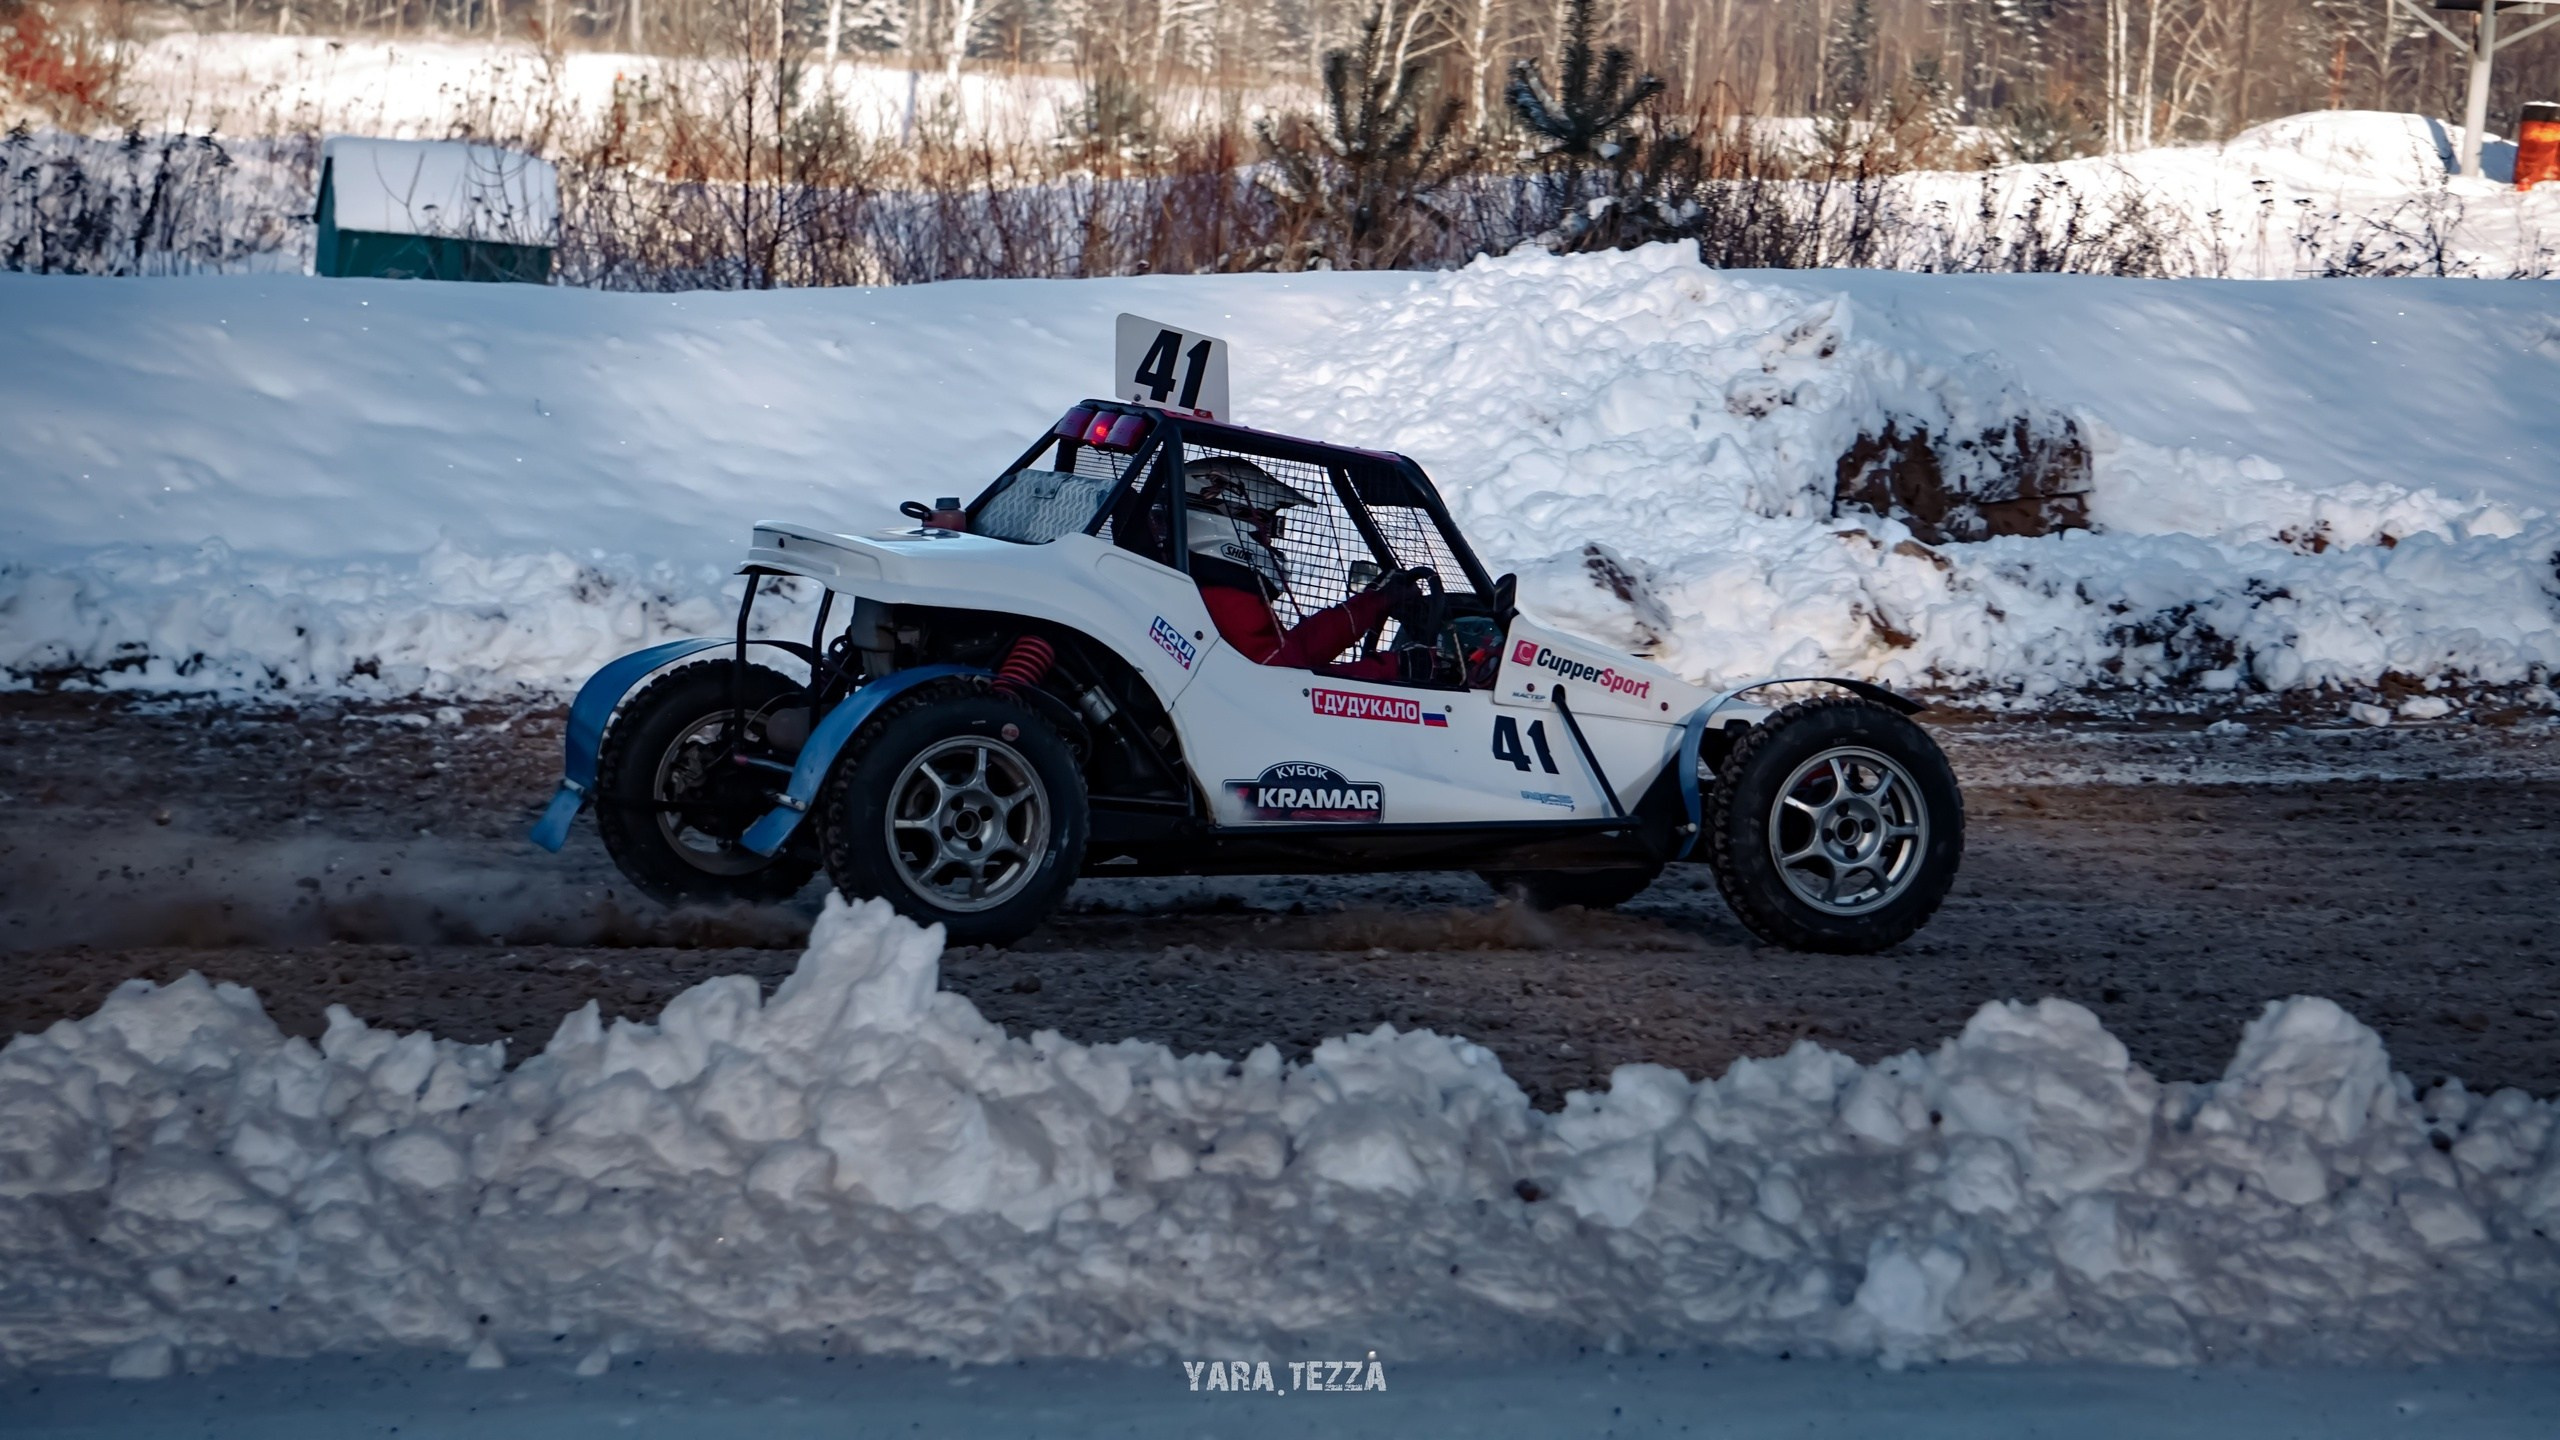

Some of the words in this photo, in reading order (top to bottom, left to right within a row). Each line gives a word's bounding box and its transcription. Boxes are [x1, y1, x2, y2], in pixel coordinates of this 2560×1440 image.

[1134, 329, 1212, 410] 41
[1151, 629, 1190, 667] MOLY
[1154, 618, 1194, 659] LIQUI
[1537, 648, 1650, 699] CupperSport
[1314, 691, 1418, 720] Г.ДУДУКАЛО
[1492, 715, 1560, 775] 41
[1276, 765, 1328, 780] КУБОК
[1258, 788, 1379, 809] KRAMAR
